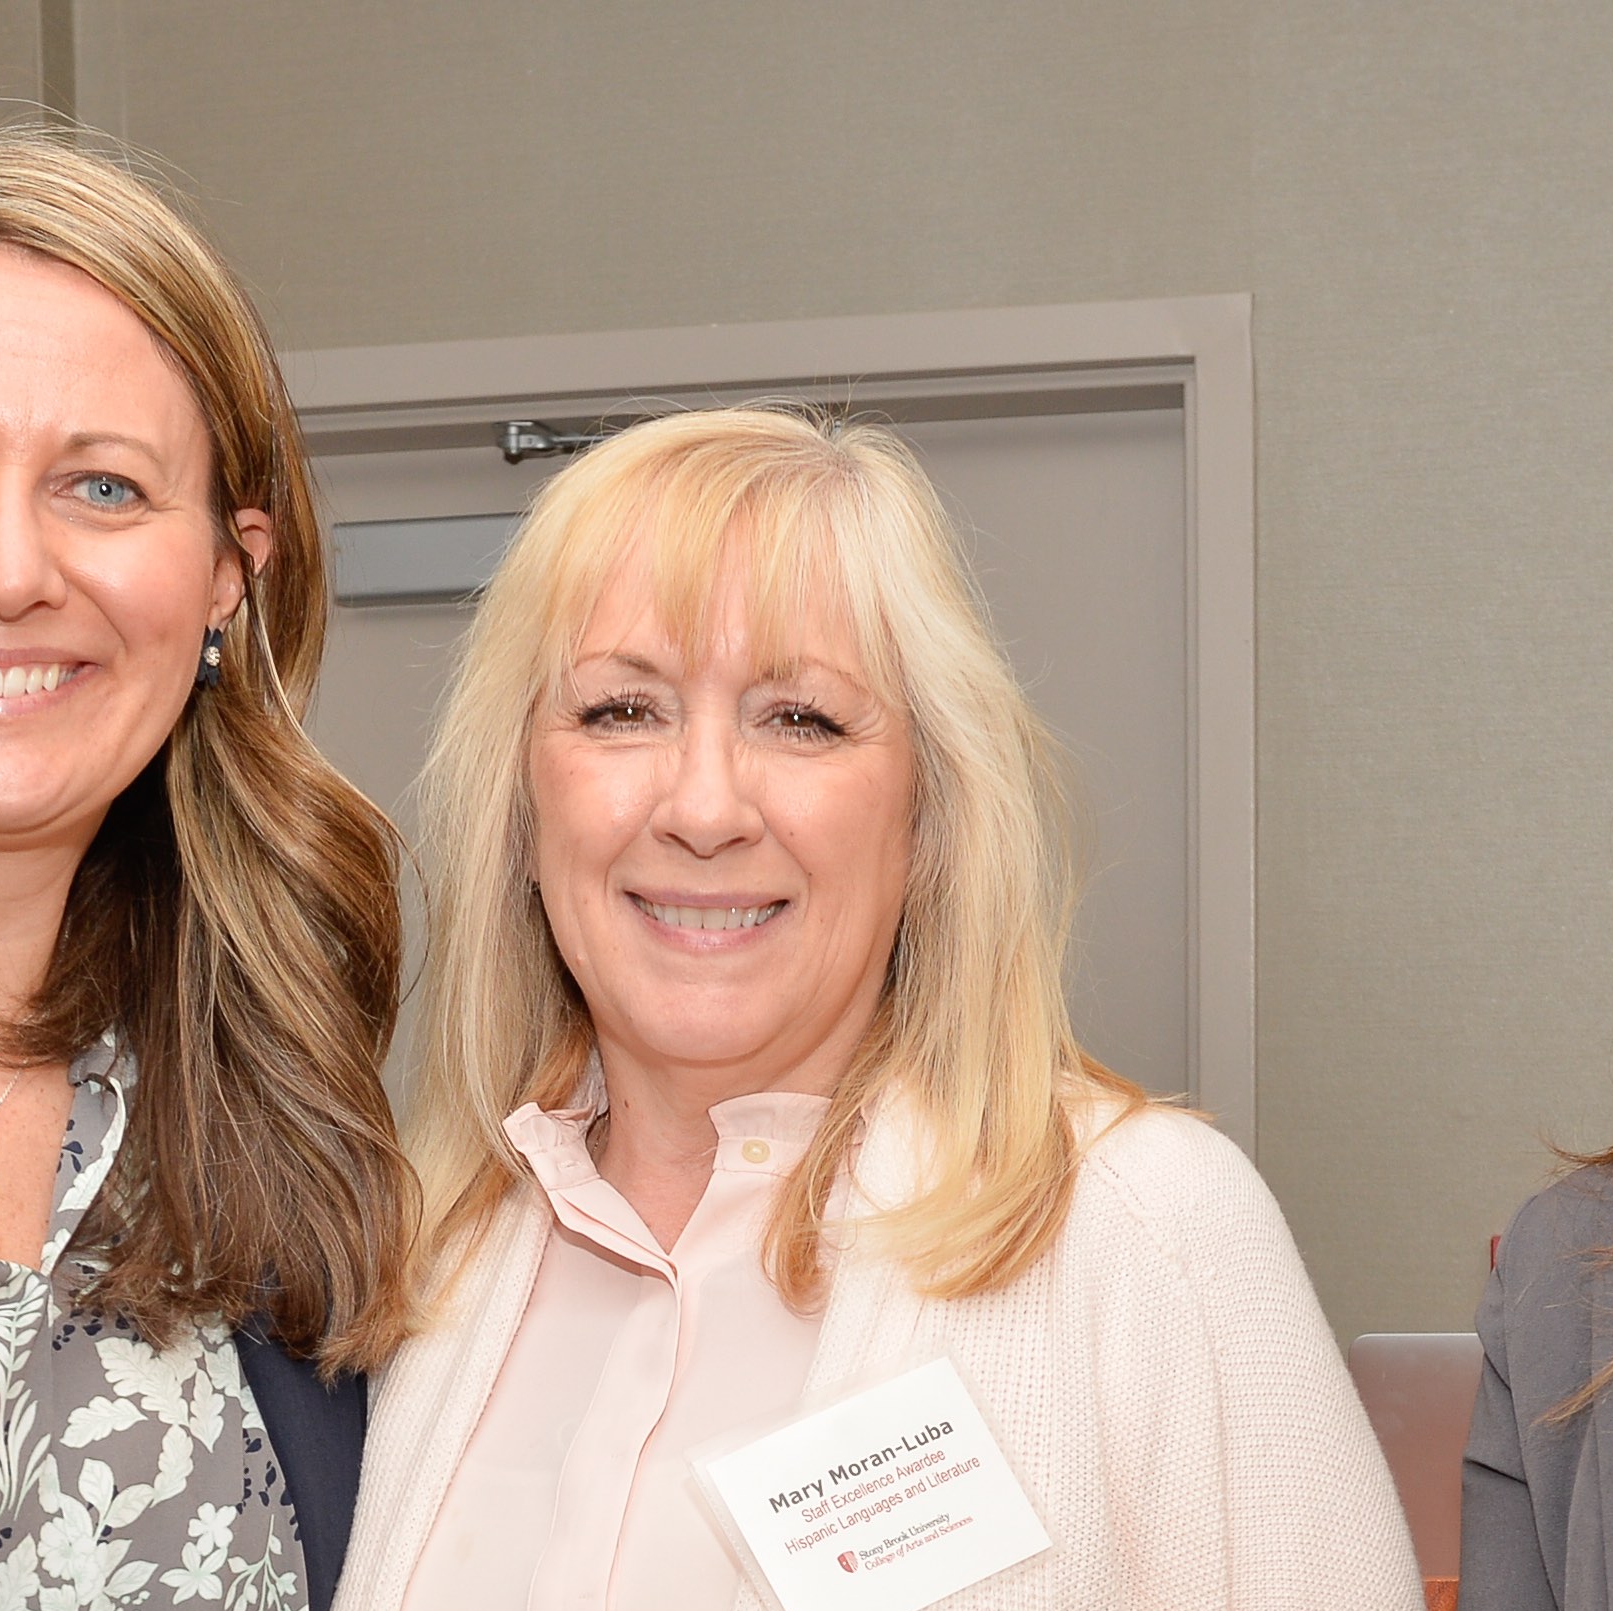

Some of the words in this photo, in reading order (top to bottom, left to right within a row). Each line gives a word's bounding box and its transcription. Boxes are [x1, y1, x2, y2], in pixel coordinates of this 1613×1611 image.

[768, 1479, 824, 1514] Mary
[828, 1421, 954, 1486] Moran-Luba
[801, 1499, 832, 1523] Staff
[830, 1473, 895, 1510] Excellence
[895, 1450, 946, 1480] Awardee
[784, 1523, 839, 1555] Hispanic
[837, 1492, 904, 1530] Languages
[904, 1478, 927, 1499] and
[925, 1457, 981, 1488] Literature
[858, 1544, 884, 1562] Stony
[882, 1531, 910, 1549] Brook
[907, 1513, 950, 1537] University
[864, 1552, 896, 1571] College
[895, 1543, 905, 1558] of
[905, 1539, 925, 1553] Arts
[923, 1529, 940, 1543] and
[938, 1516, 974, 1536] Sciences
